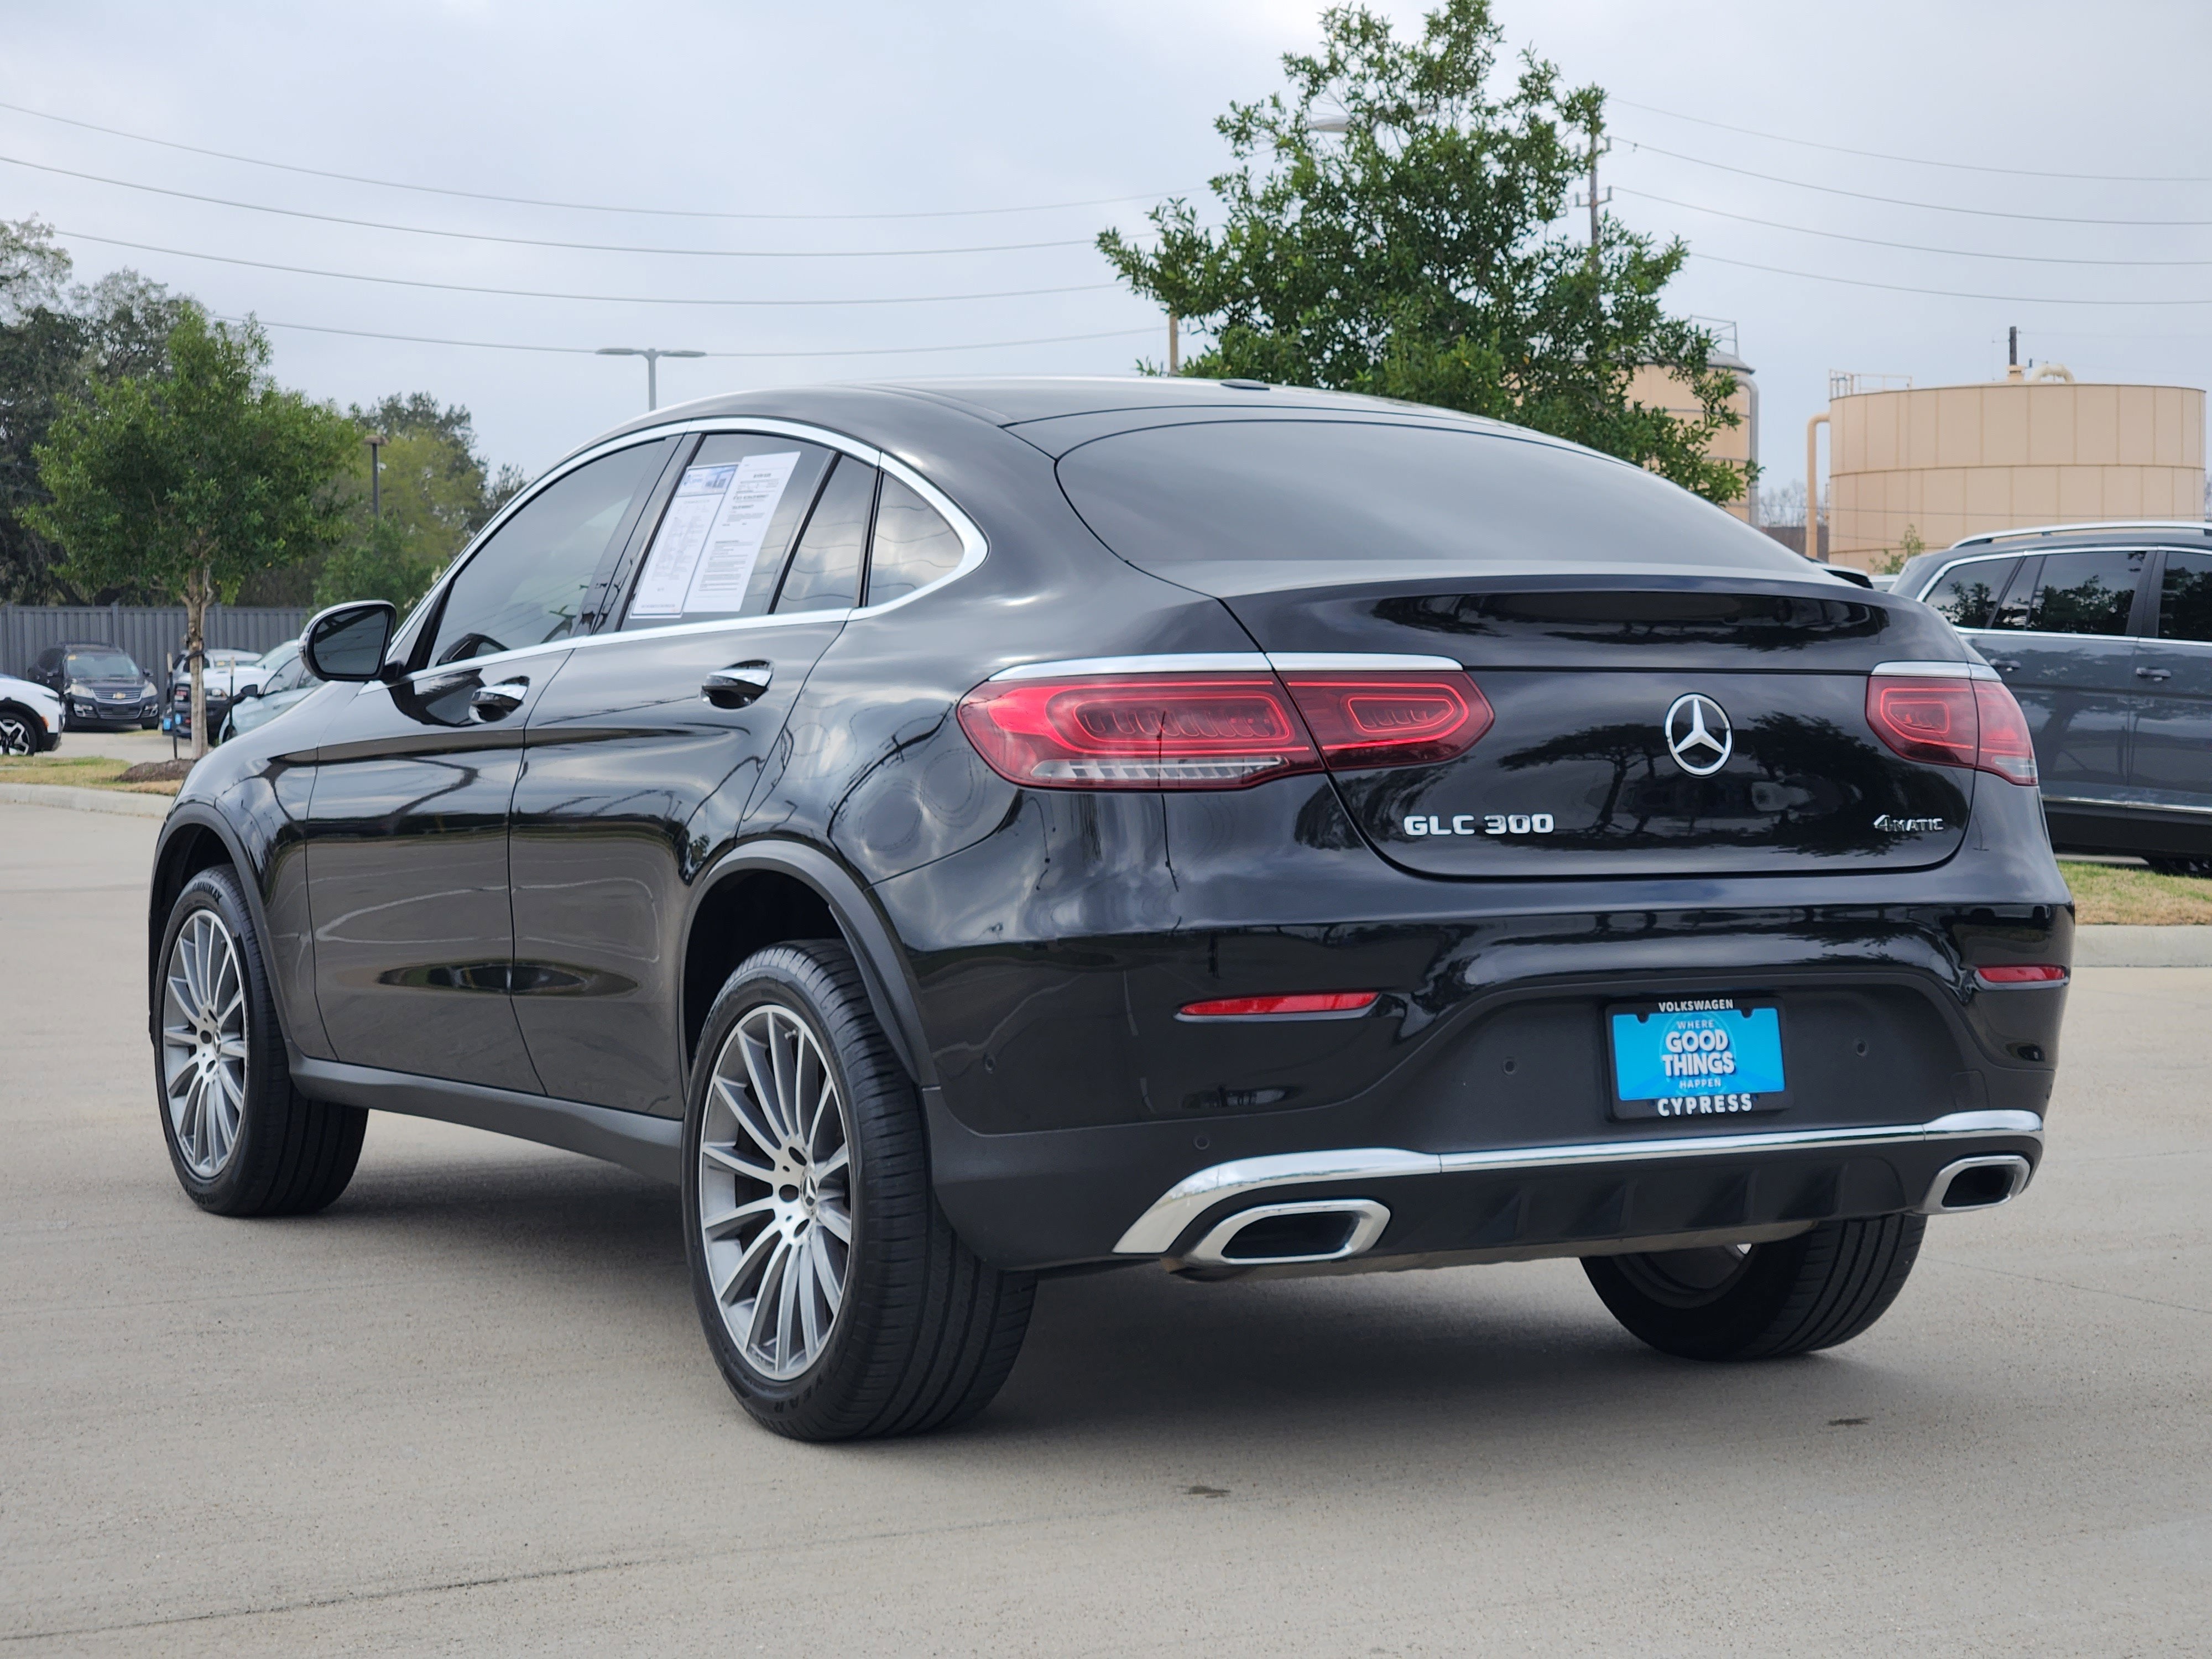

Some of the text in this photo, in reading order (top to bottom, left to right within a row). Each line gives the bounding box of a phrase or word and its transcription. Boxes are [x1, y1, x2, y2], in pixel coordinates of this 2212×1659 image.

[1404, 814, 1554, 836] GLC 300
[1874, 815, 1944, 832] 4MATIC
[1658, 999, 1734, 1013] VOLKSWAGEN
[1677, 1020, 1714, 1029] WHERE
[1666, 1029, 1729, 1053] GOOD
[1662, 1051, 1735, 1077] THINGS
[1679, 1077, 1721, 1089] HAPPEN
[1657, 1093, 1752, 1117] CYPRESS
